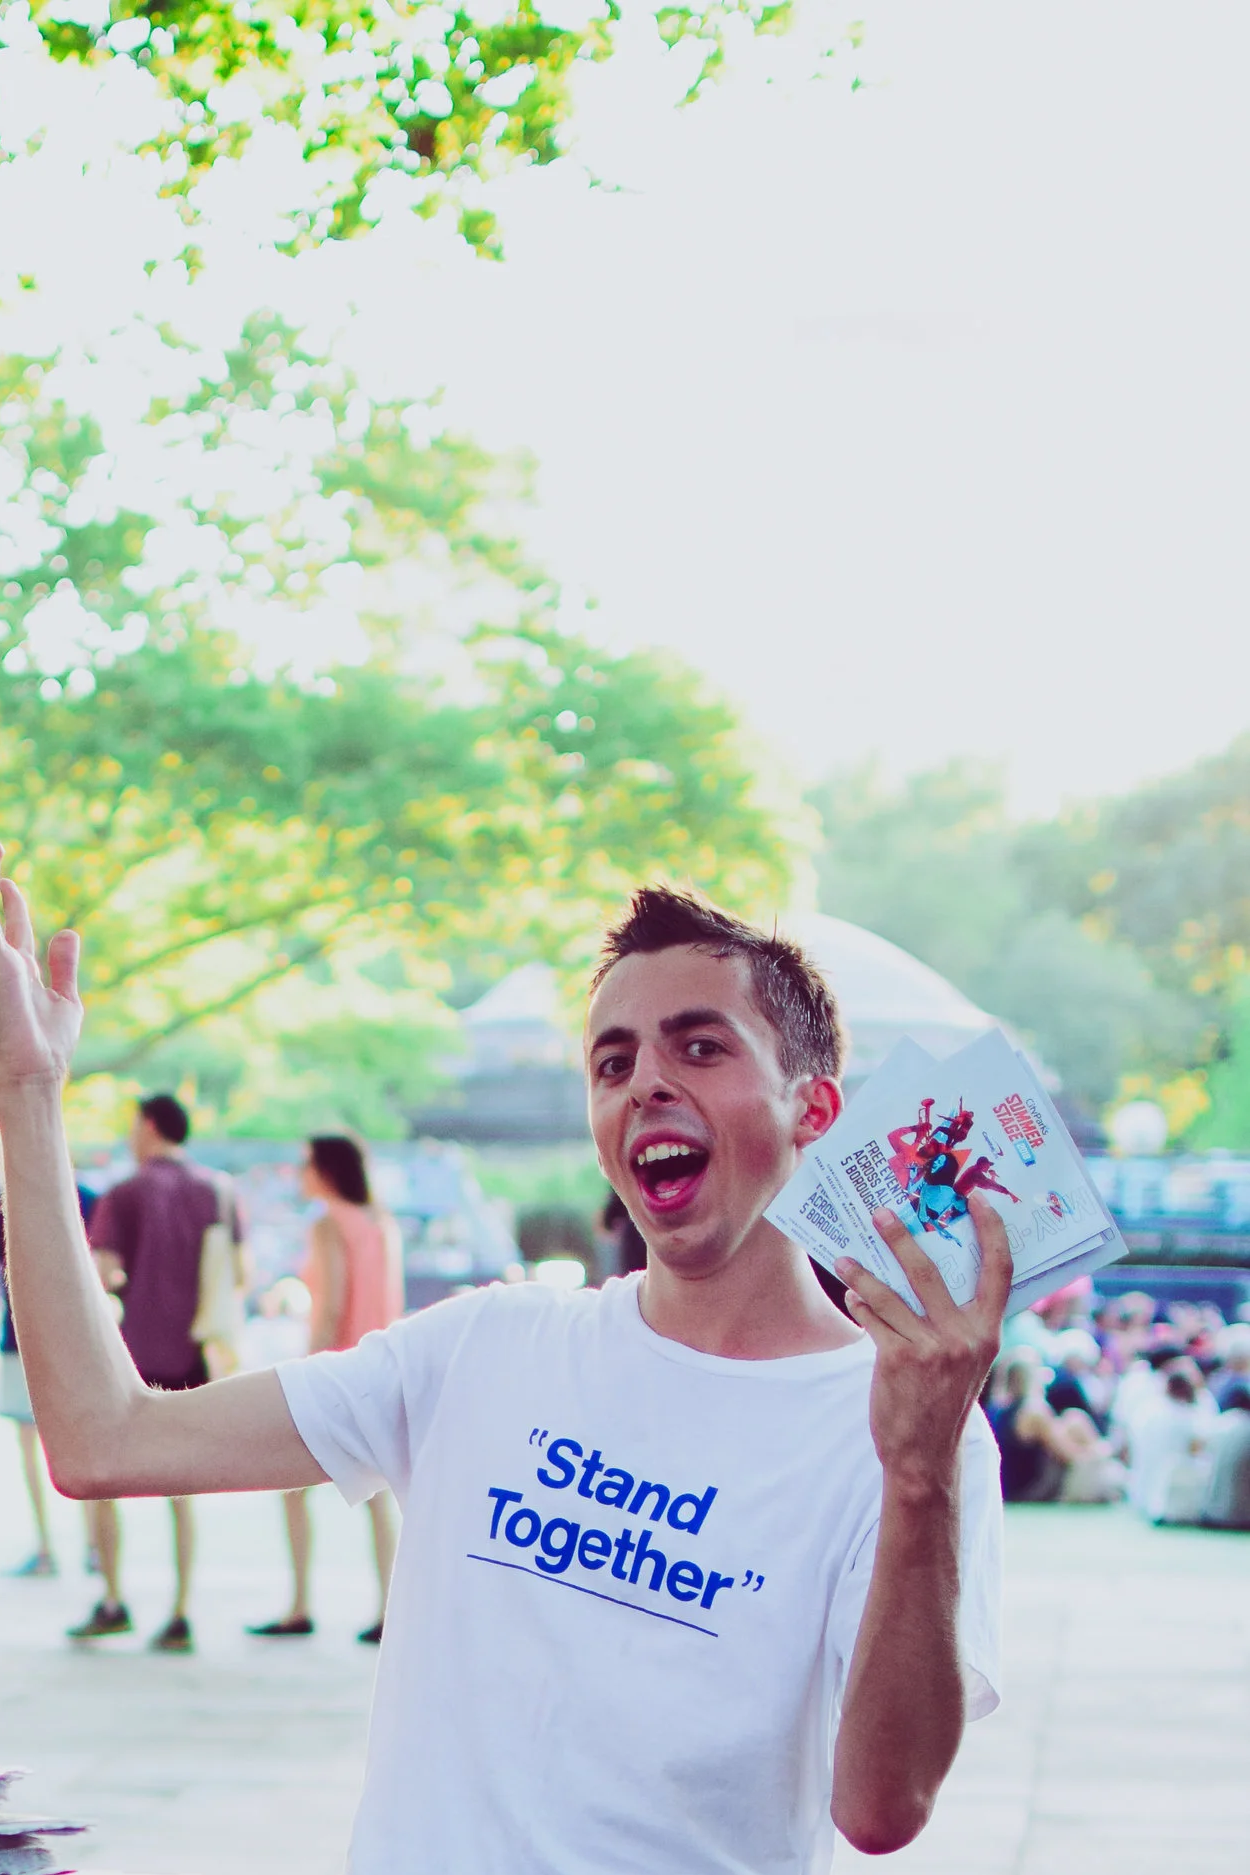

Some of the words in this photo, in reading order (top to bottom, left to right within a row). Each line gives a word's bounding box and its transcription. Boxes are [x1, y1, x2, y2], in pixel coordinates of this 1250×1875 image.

[993, 1103, 1024, 1142] STAGE
[1005, 1093, 1044, 1148] SUMMER
[840, 1155, 853, 1167] 5
[852, 1149, 882, 1189] ACROSS
[865, 1140, 887, 1168] FREE
[879, 1166, 907, 1206] EVENTS
[799, 1202, 810, 1215] 5
[806, 1208, 850, 1249] BOROUGHS
[808, 1191, 839, 1223] ACROSS
